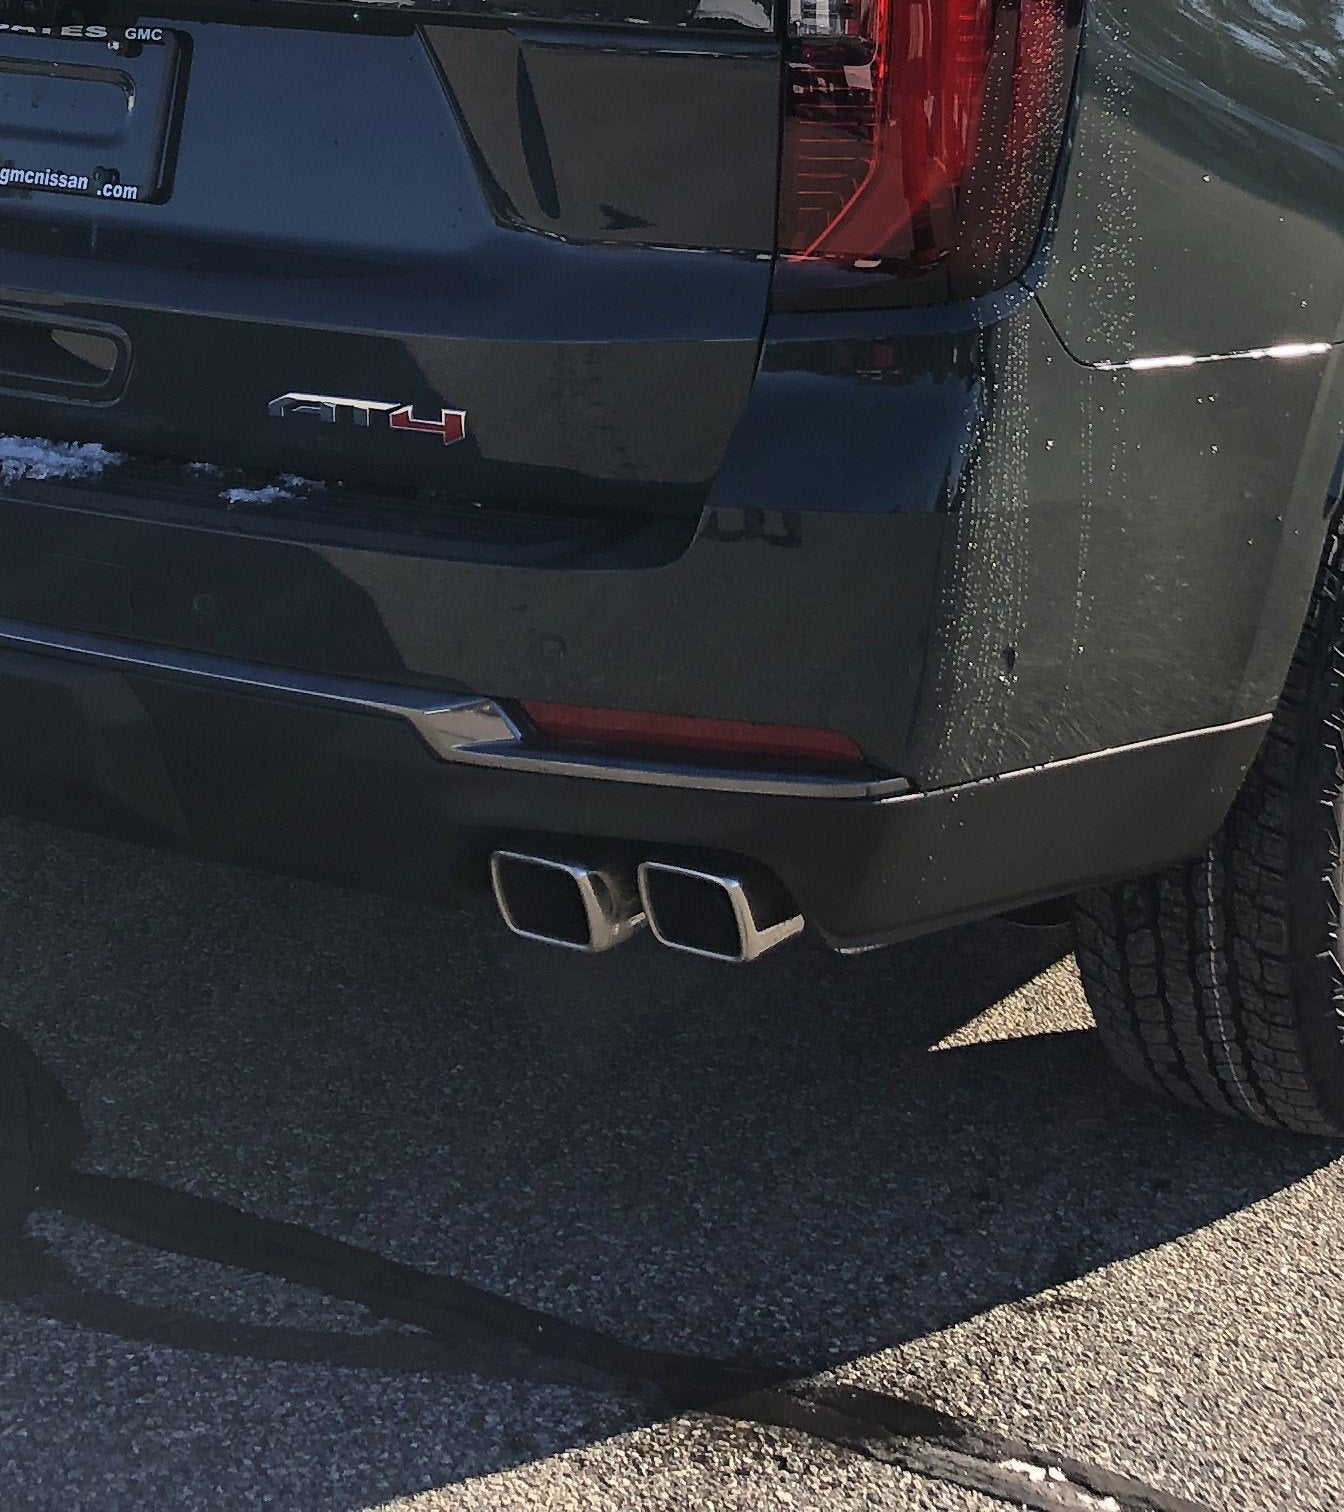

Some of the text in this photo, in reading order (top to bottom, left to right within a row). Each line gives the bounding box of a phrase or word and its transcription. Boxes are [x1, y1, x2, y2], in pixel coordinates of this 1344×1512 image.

[124, 27, 163, 41] GMC
[96, 183, 138, 199] .com
[268, 392, 466, 445] AT4
